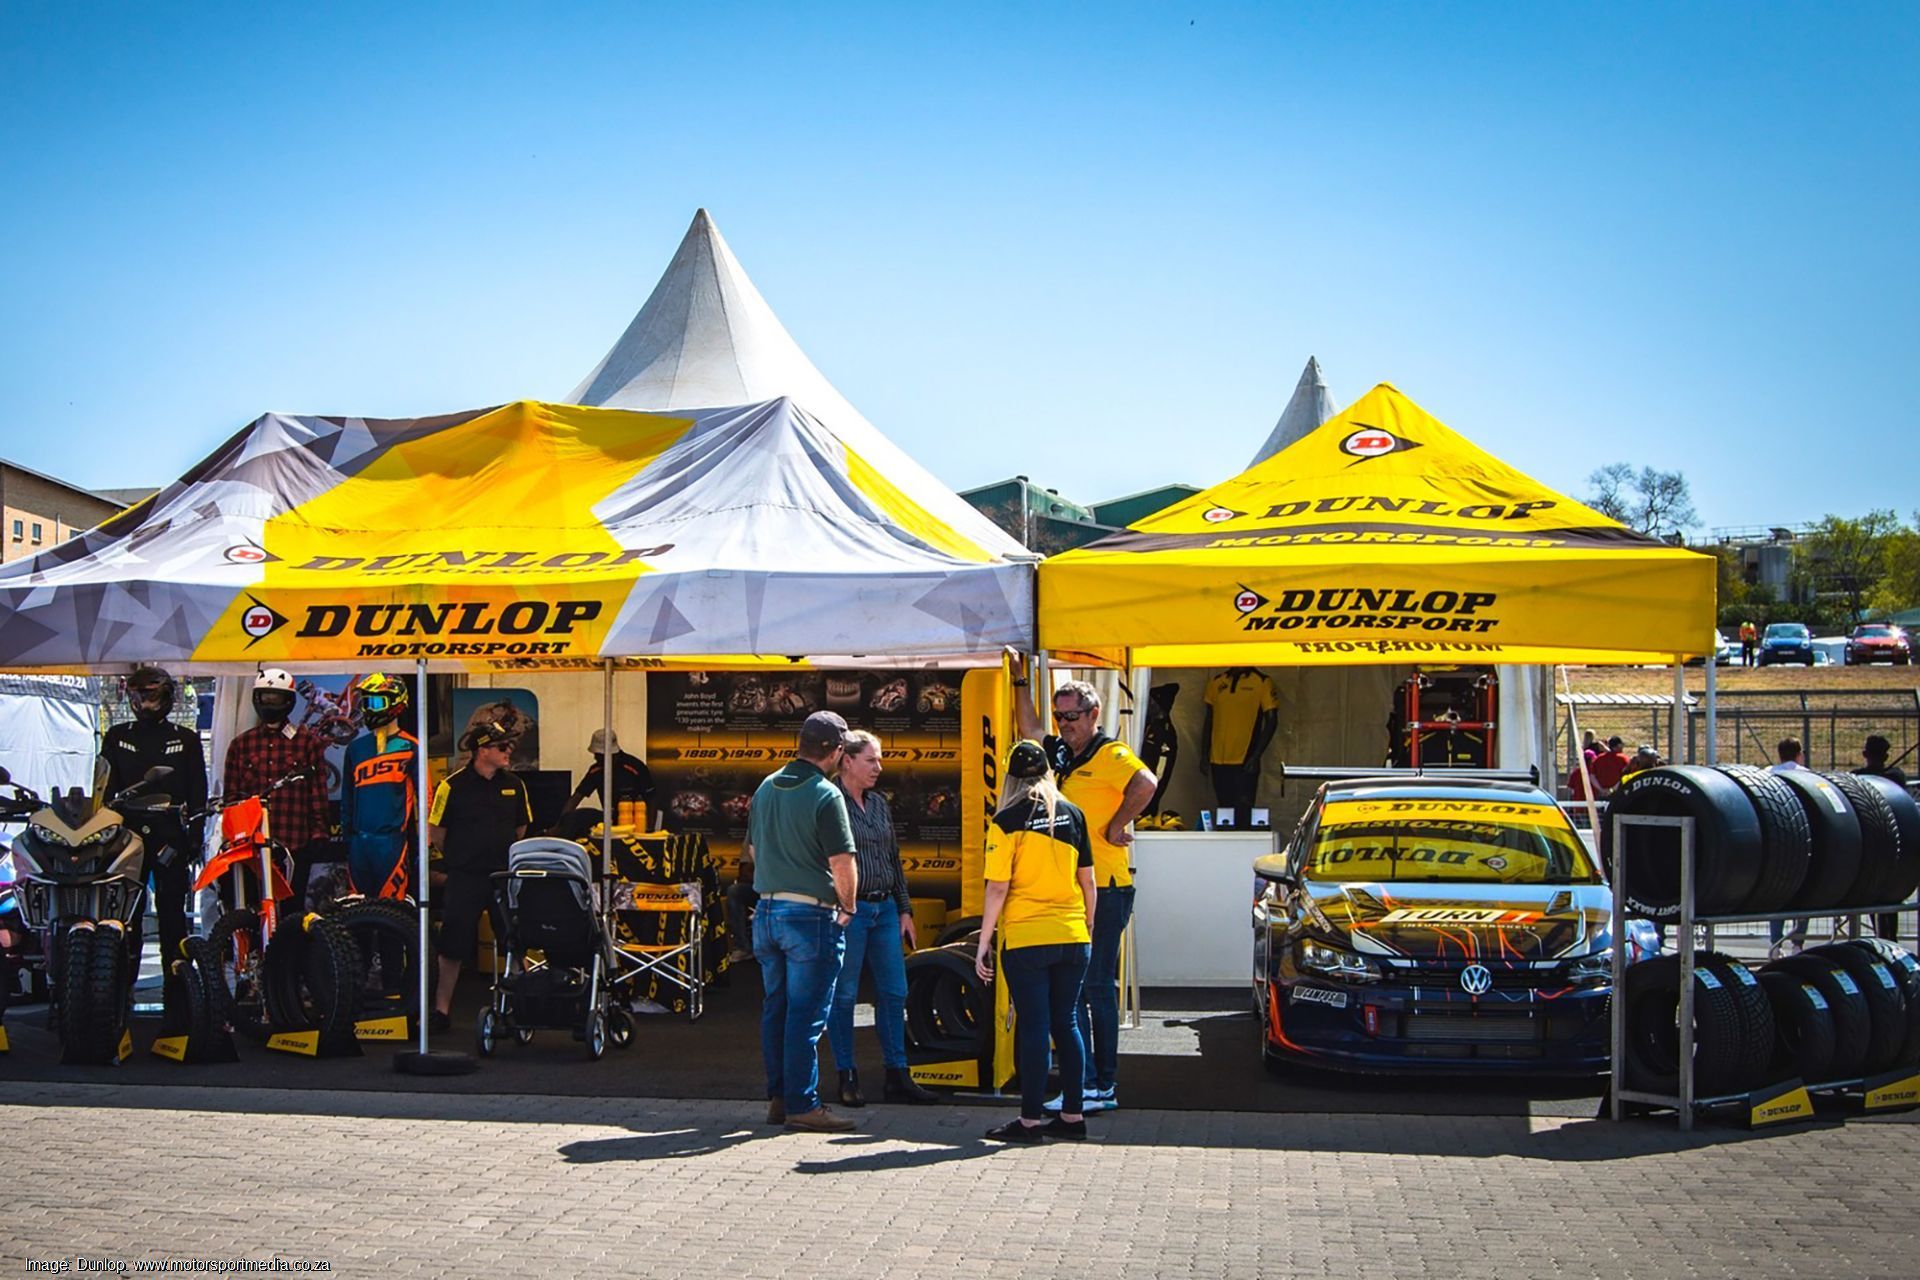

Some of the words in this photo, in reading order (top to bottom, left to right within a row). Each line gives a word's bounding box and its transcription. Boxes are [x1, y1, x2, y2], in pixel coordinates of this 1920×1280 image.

[1256, 497, 1557, 520] DUNLOP
[1205, 531, 1565, 548] MOTORSPORT
[289, 544, 676, 570] DUNLOP
[1274, 589, 1497, 614] DUNLOP
[296, 601, 602, 637] DUNLOP
[1243, 614, 1499, 632] MOTORSPORT
[357, 641, 572, 656] MOTORSPORT
[700, 692, 716, 701] Boyd
[676, 709, 710, 717] pneumatic
[711, 709, 723, 718] tyre
[690, 717, 706, 725] years
[684, 749, 717, 758] 1888
[729, 749, 763, 758] 1949
[882, 751, 908, 759] 974
[924, 751, 956, 759] 1975
[1633, 777, 1692, 795] DUNLOP
[1387, 803, 1542, 816] DUNLOP
[923, 859, 957, 869] 2019
[636, 893, 689, 901] DUNLOP
[1400, 910, 1490, 921] TURN
[913, 1072, 963, 1081] DUNLOP
[1882, 1091, 1917, 1101] DUNLOP
[1767, 1104, 1801, 1116] DUNLOP
